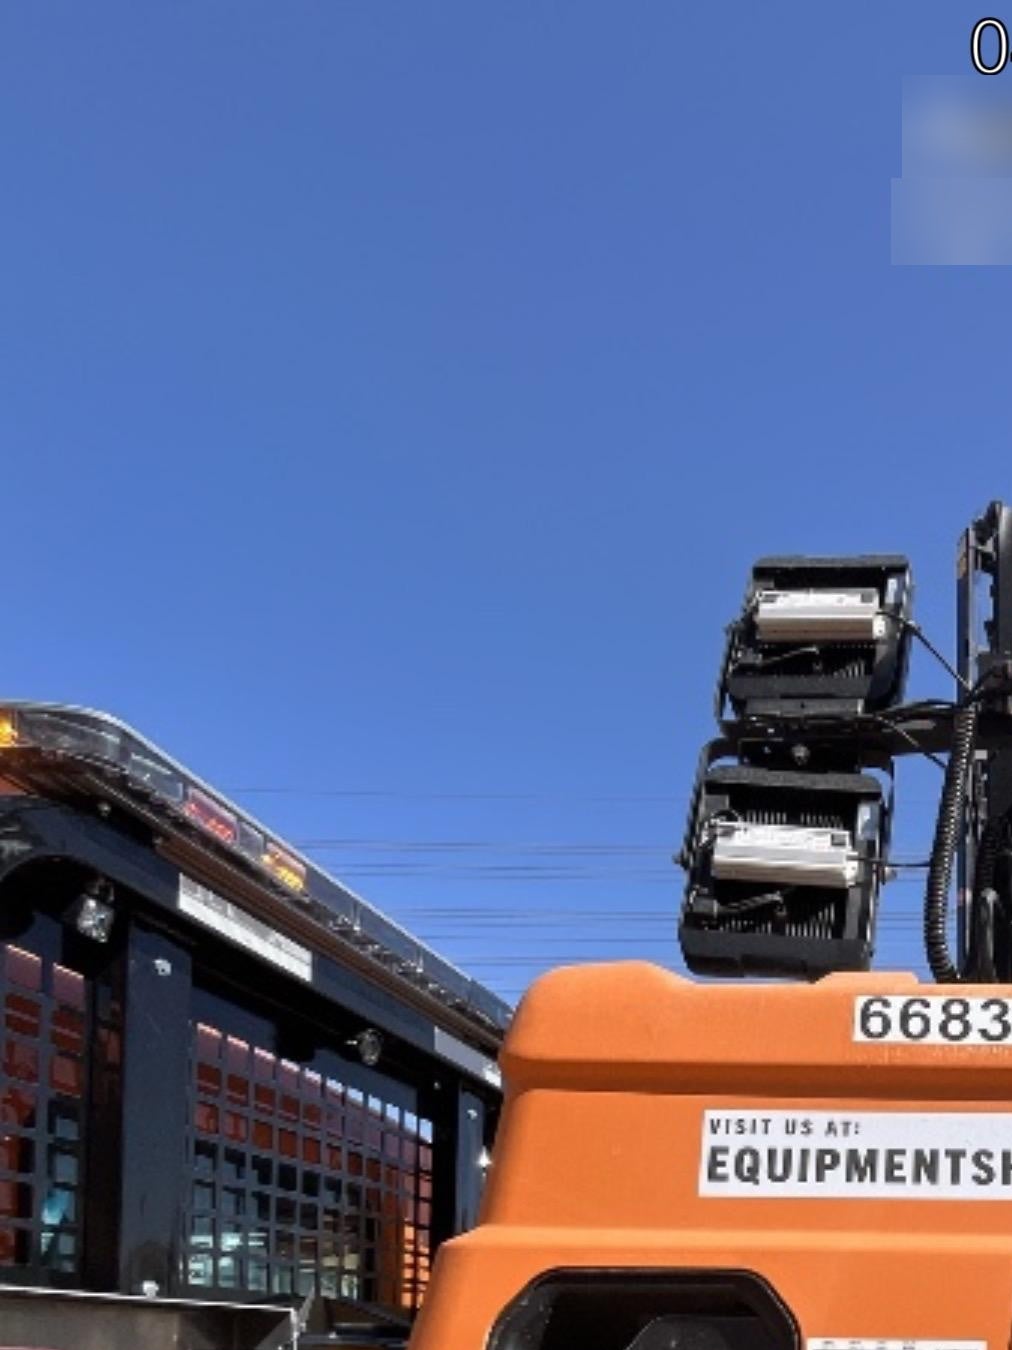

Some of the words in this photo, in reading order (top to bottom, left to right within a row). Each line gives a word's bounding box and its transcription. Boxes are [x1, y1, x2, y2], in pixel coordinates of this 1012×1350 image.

[709, 1118, 772, 1135] VISIT
[784, 1119, 813, 1136] US
[824, 1120, 861, 1137] AT:
